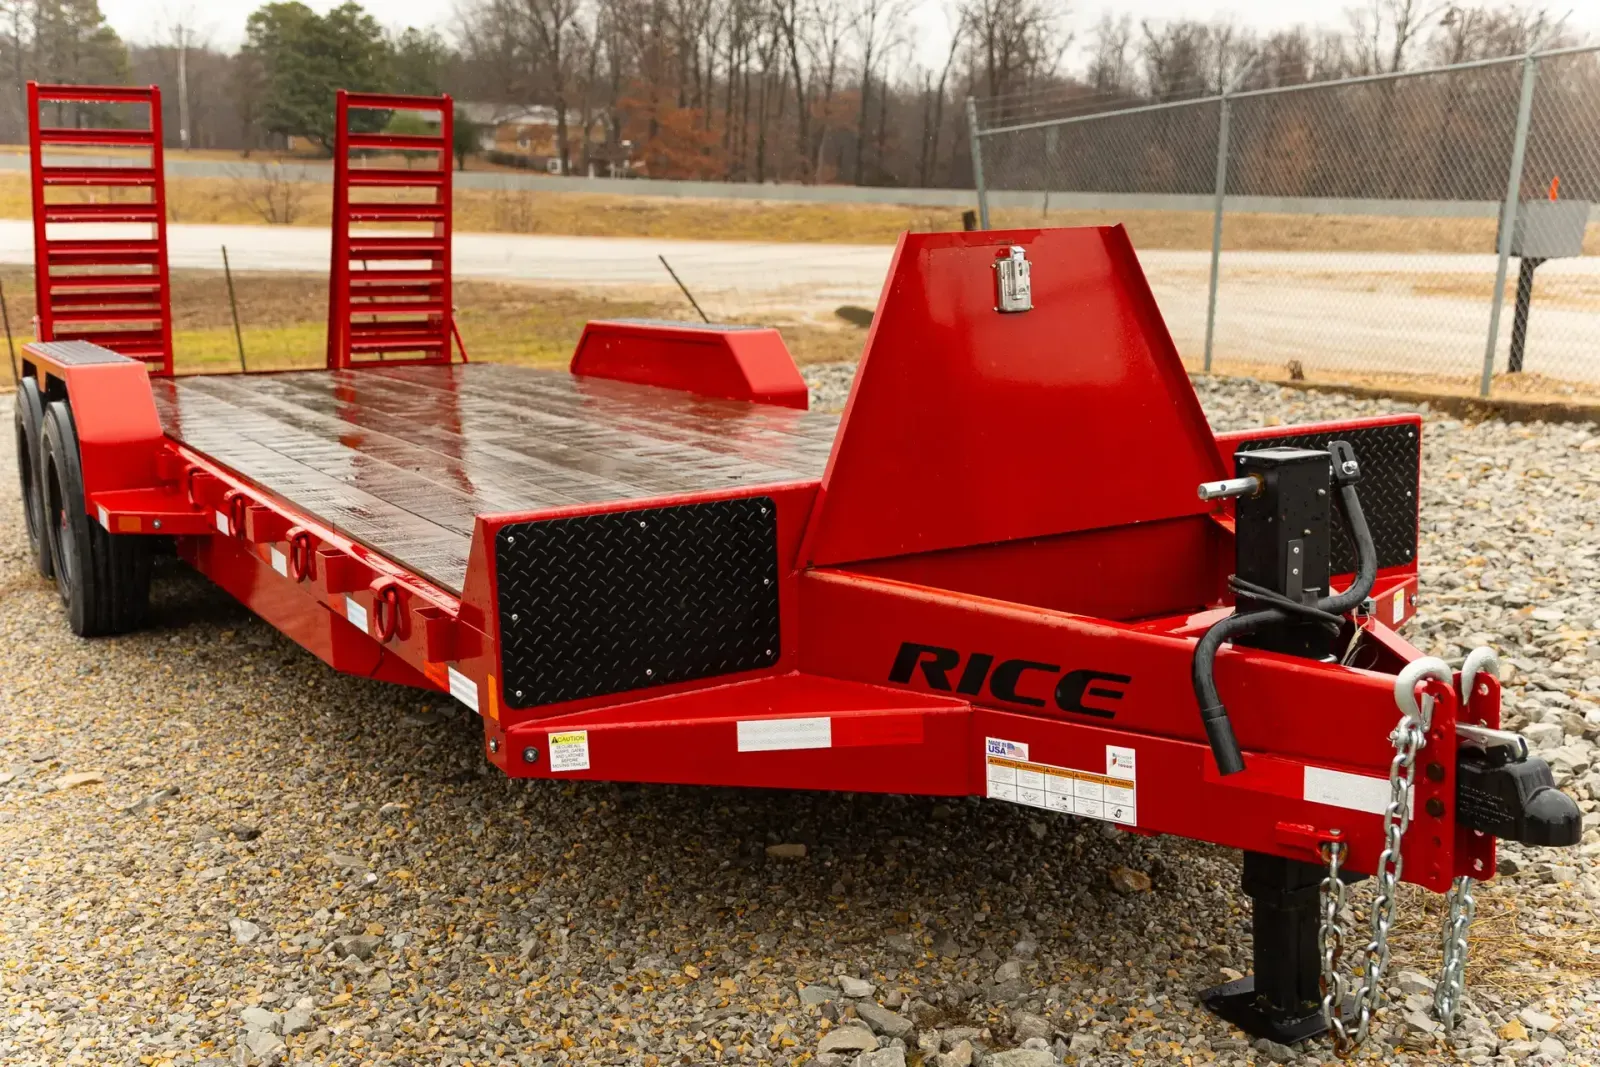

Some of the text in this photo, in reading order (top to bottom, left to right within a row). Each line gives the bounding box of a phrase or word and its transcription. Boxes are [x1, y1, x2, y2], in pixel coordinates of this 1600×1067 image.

[887, 641, 1132, 720] RICE
[988, 739, 1001, 747] MADE
[988, 745, 1006, 755] USA
